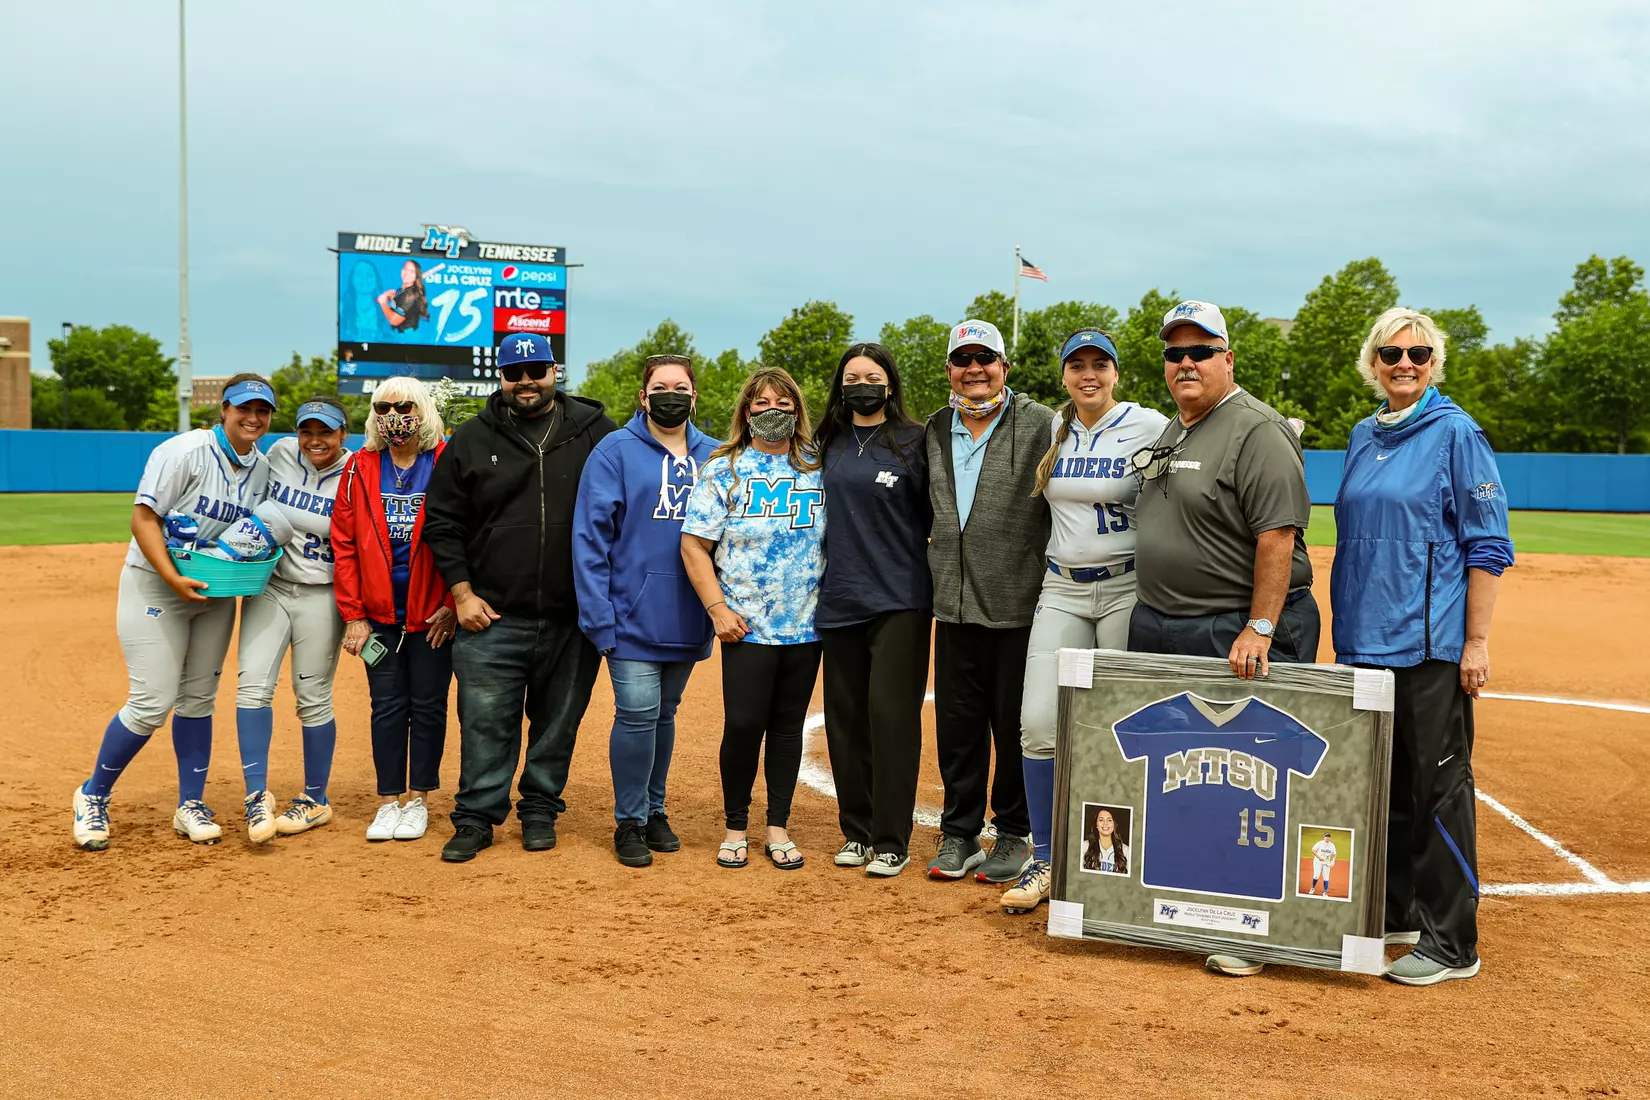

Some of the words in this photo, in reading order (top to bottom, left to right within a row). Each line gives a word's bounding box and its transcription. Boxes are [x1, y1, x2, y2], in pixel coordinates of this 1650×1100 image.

[355, 235, 413, 253] MIDDLE
[421, 227, 464, 258] MT
[478, 243, 557, 263] TENNESSEE
[425, 274, 442, 284] DE
[443, 274, 459, 285] LA
[460, 275, 492, 286] CRUZ
[521, 271, 557, 283] pepsi
[495, 287, 541, 310] mte
[1172, 303, 1199, 319] MT
[507, 315, 551, 329] Ascend
[1050, 457, 1127, 479] AIDERS
[875, 470, 900, 488] MT
[270, 480, 335, 518] RAIDER
[1474, 484, 1497, 499] MT
[741, 478, 823, 530] MT
[1093, 502, 1130, 535] 15
[237, 521, 264, 543] MT
[303, 532, 335, 563] 23
[1162, 747, 1278, 801] MTSU
[1237, 808, 1276, 849] 15
[1159, 905, 1179, 920] MT
[1240, 914, 1263, 929] MT
